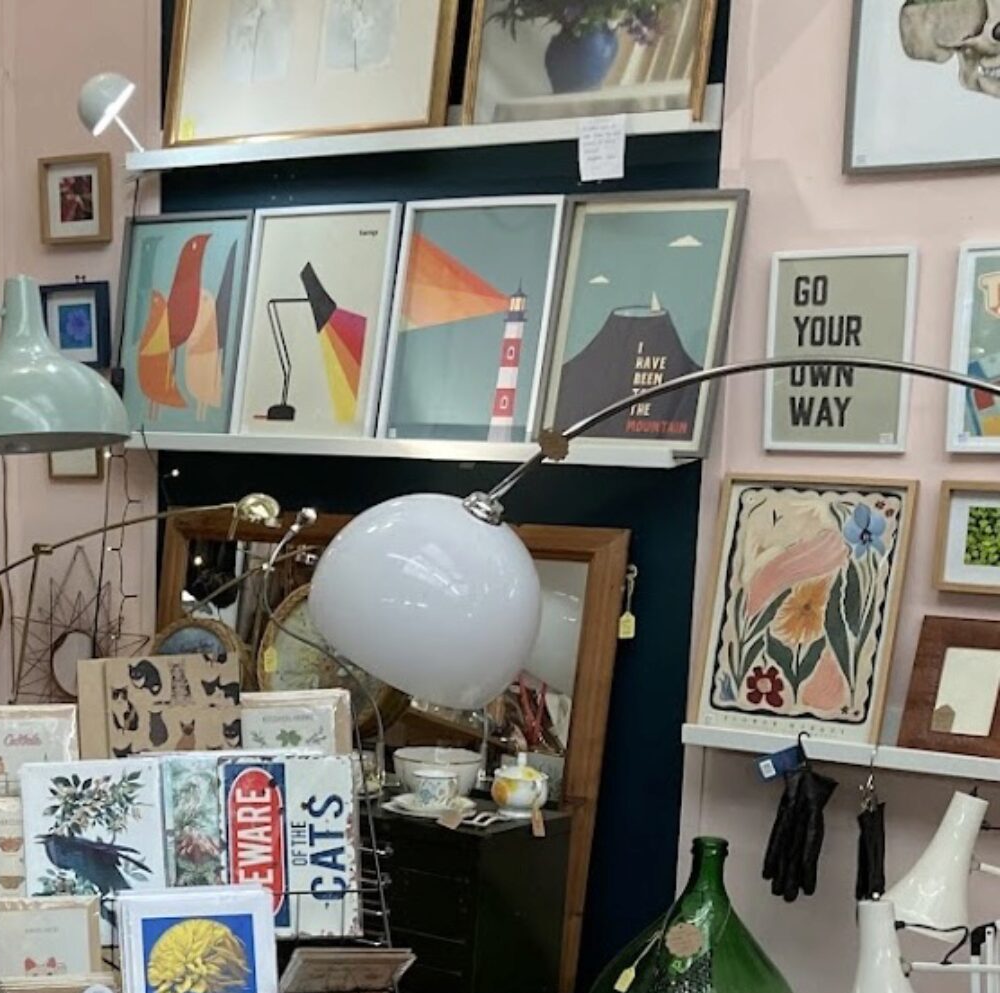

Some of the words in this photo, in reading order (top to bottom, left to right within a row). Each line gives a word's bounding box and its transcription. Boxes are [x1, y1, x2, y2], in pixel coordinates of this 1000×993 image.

[794, 275, 828, 306] GO
[793, 316, 862, 347] YOUR
[637, 341, 644, 354] I
[635, 356, 667, 370] HAVE
[632, 372, 664, 386] BEEN
[790, 364, 854, 387] OWN
[630, 402, 652, 417] THE
[789, 396, 852, 427] WAY
[625, 420, 688, 433] MOUNTAIN
[235, 787, 275, 888] EWARE
[290, 821, 307, 847] THE
[291, 849, 308, 866] OF
[307, 794, 346, 900] CATS
